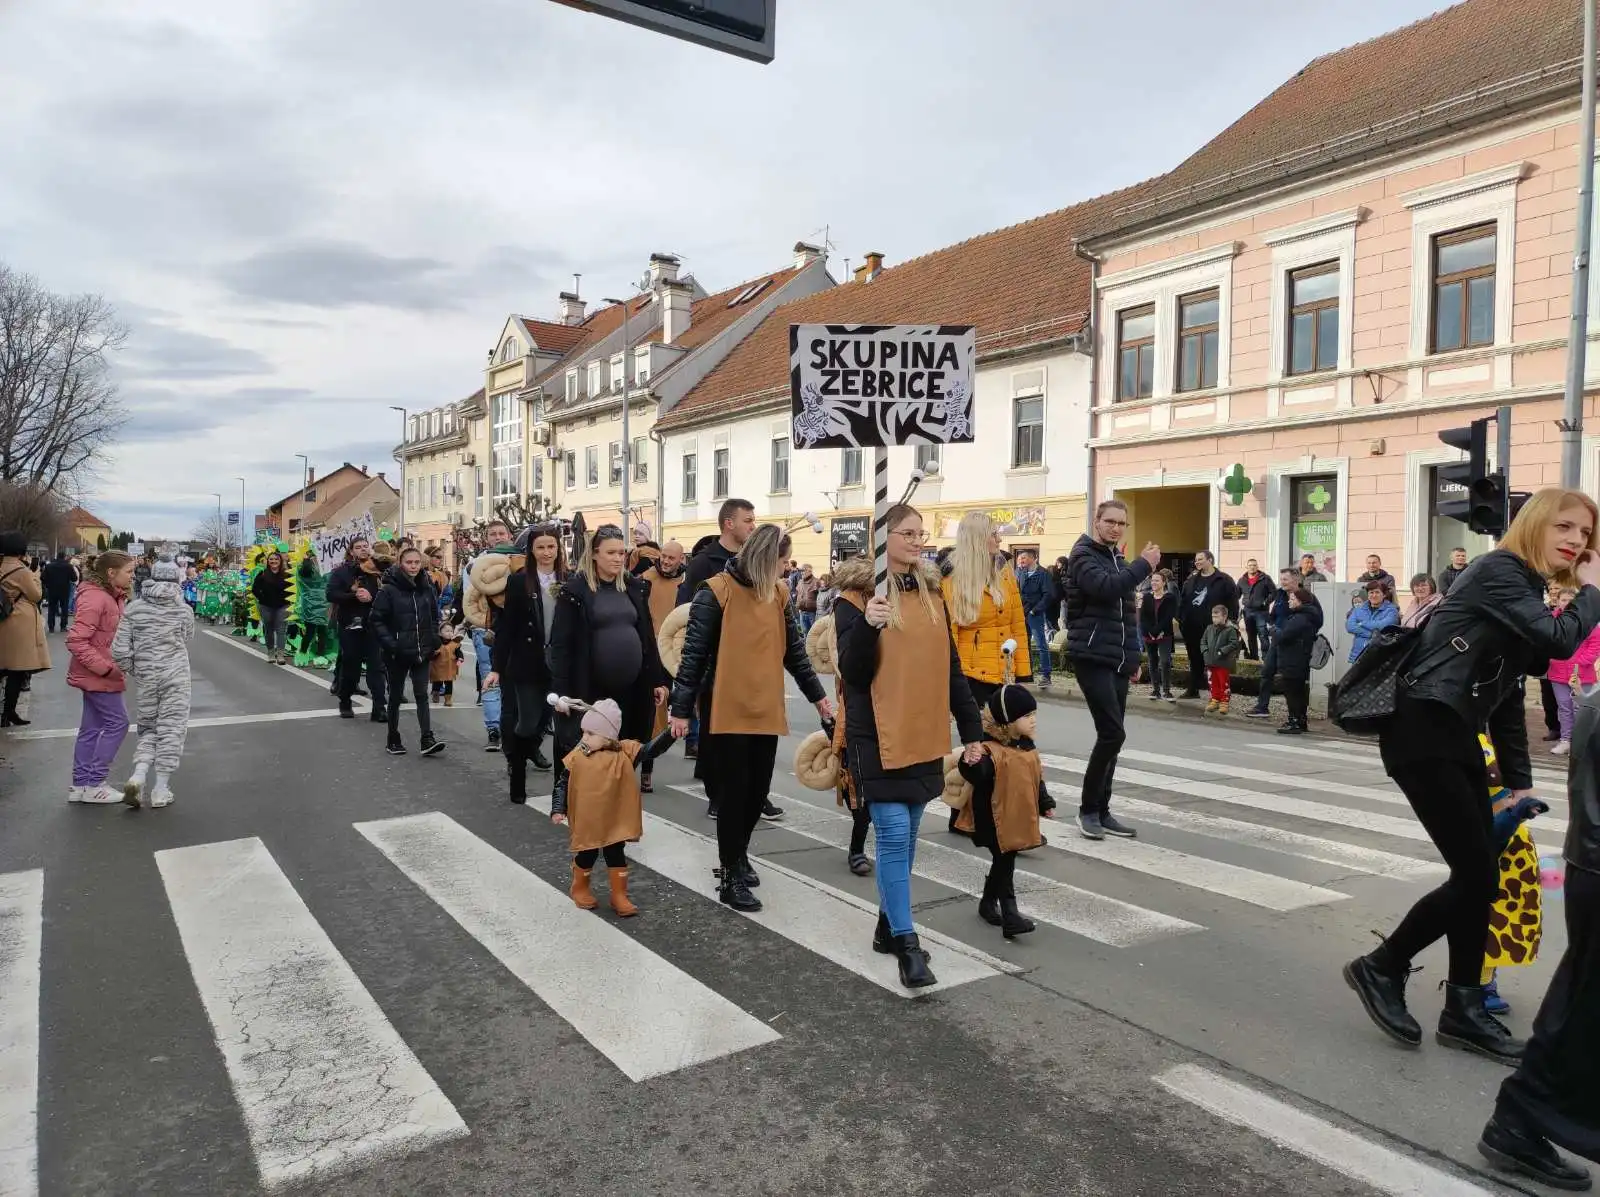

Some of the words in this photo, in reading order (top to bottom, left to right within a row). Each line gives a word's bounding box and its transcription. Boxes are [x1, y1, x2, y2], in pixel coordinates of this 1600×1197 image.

[810, 338, 960, 370] SKUPINA
[819, 369, 946, 400] ZEBRICE
[832, 521, 867, 532] ADMIRAL
